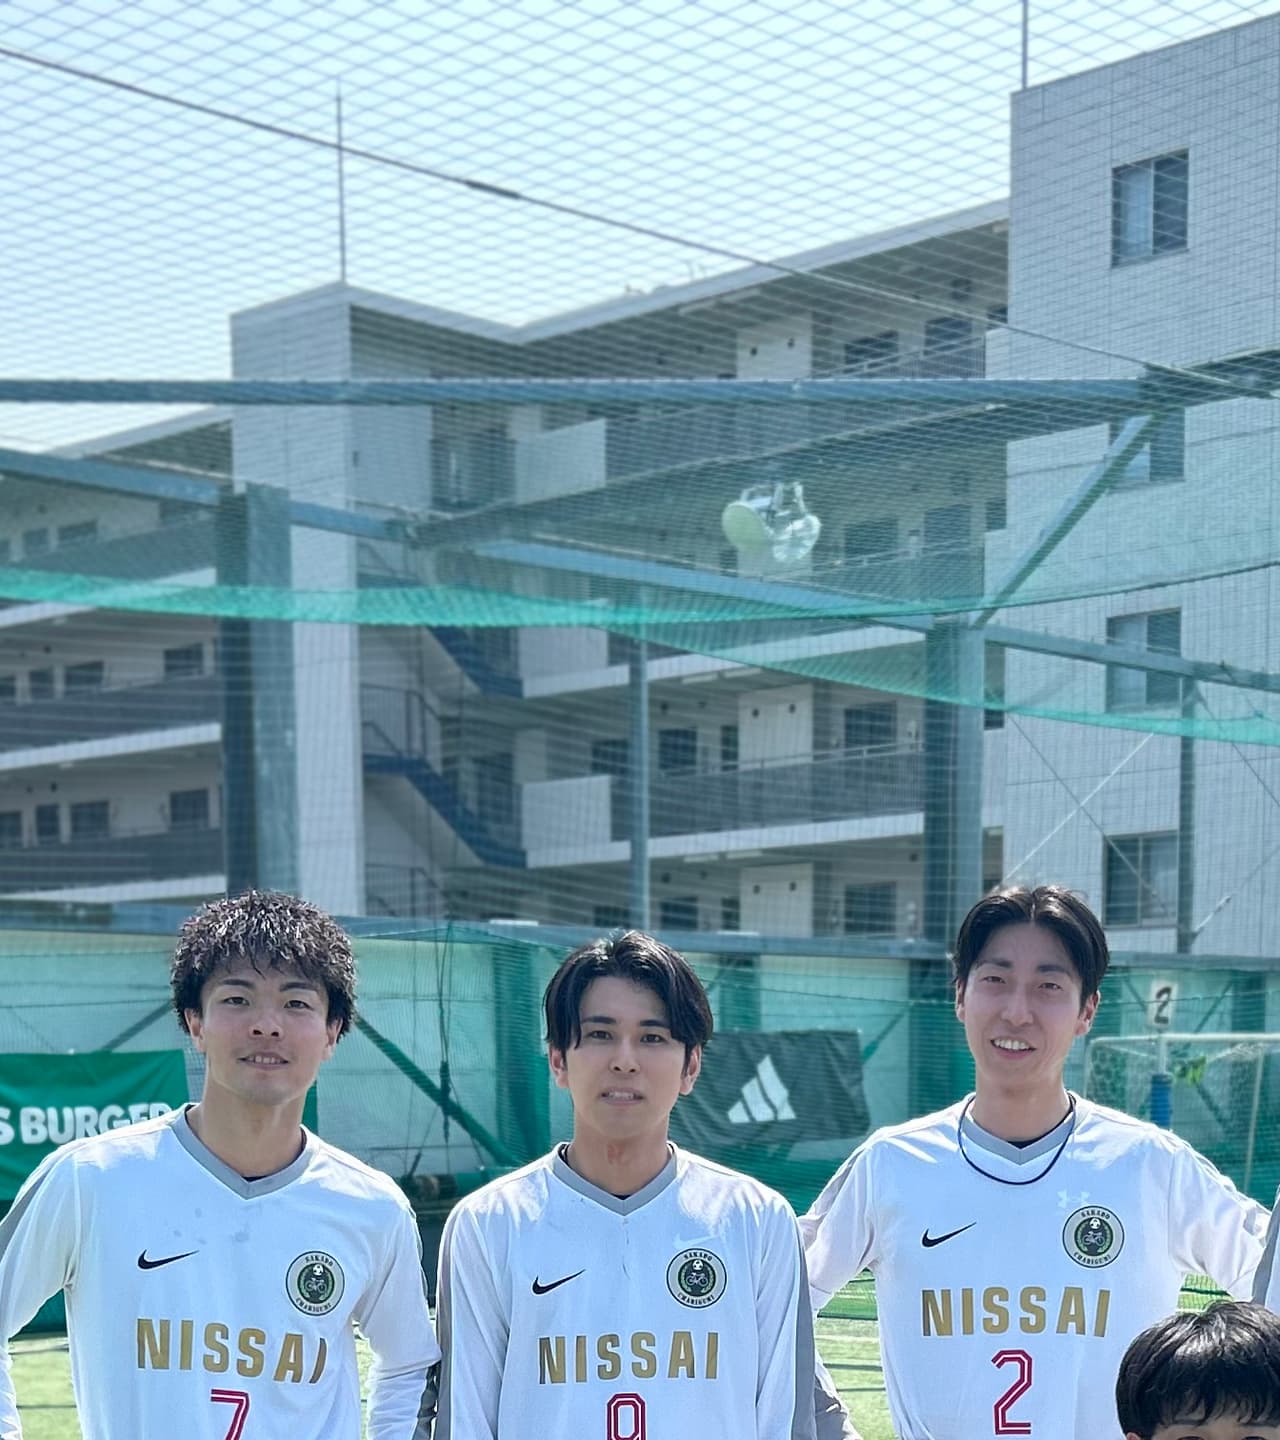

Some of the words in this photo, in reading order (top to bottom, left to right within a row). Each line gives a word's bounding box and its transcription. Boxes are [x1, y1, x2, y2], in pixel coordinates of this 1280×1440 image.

[1154, 986, 1172, 1025] 2
[922, 1286, 1111, 1338] NISSAI
[136, 1318, 327, 1384] NISSAI
[538, 1331, 719, 1384] NISSAI
[991, 1349, 1033, 1435] 2
